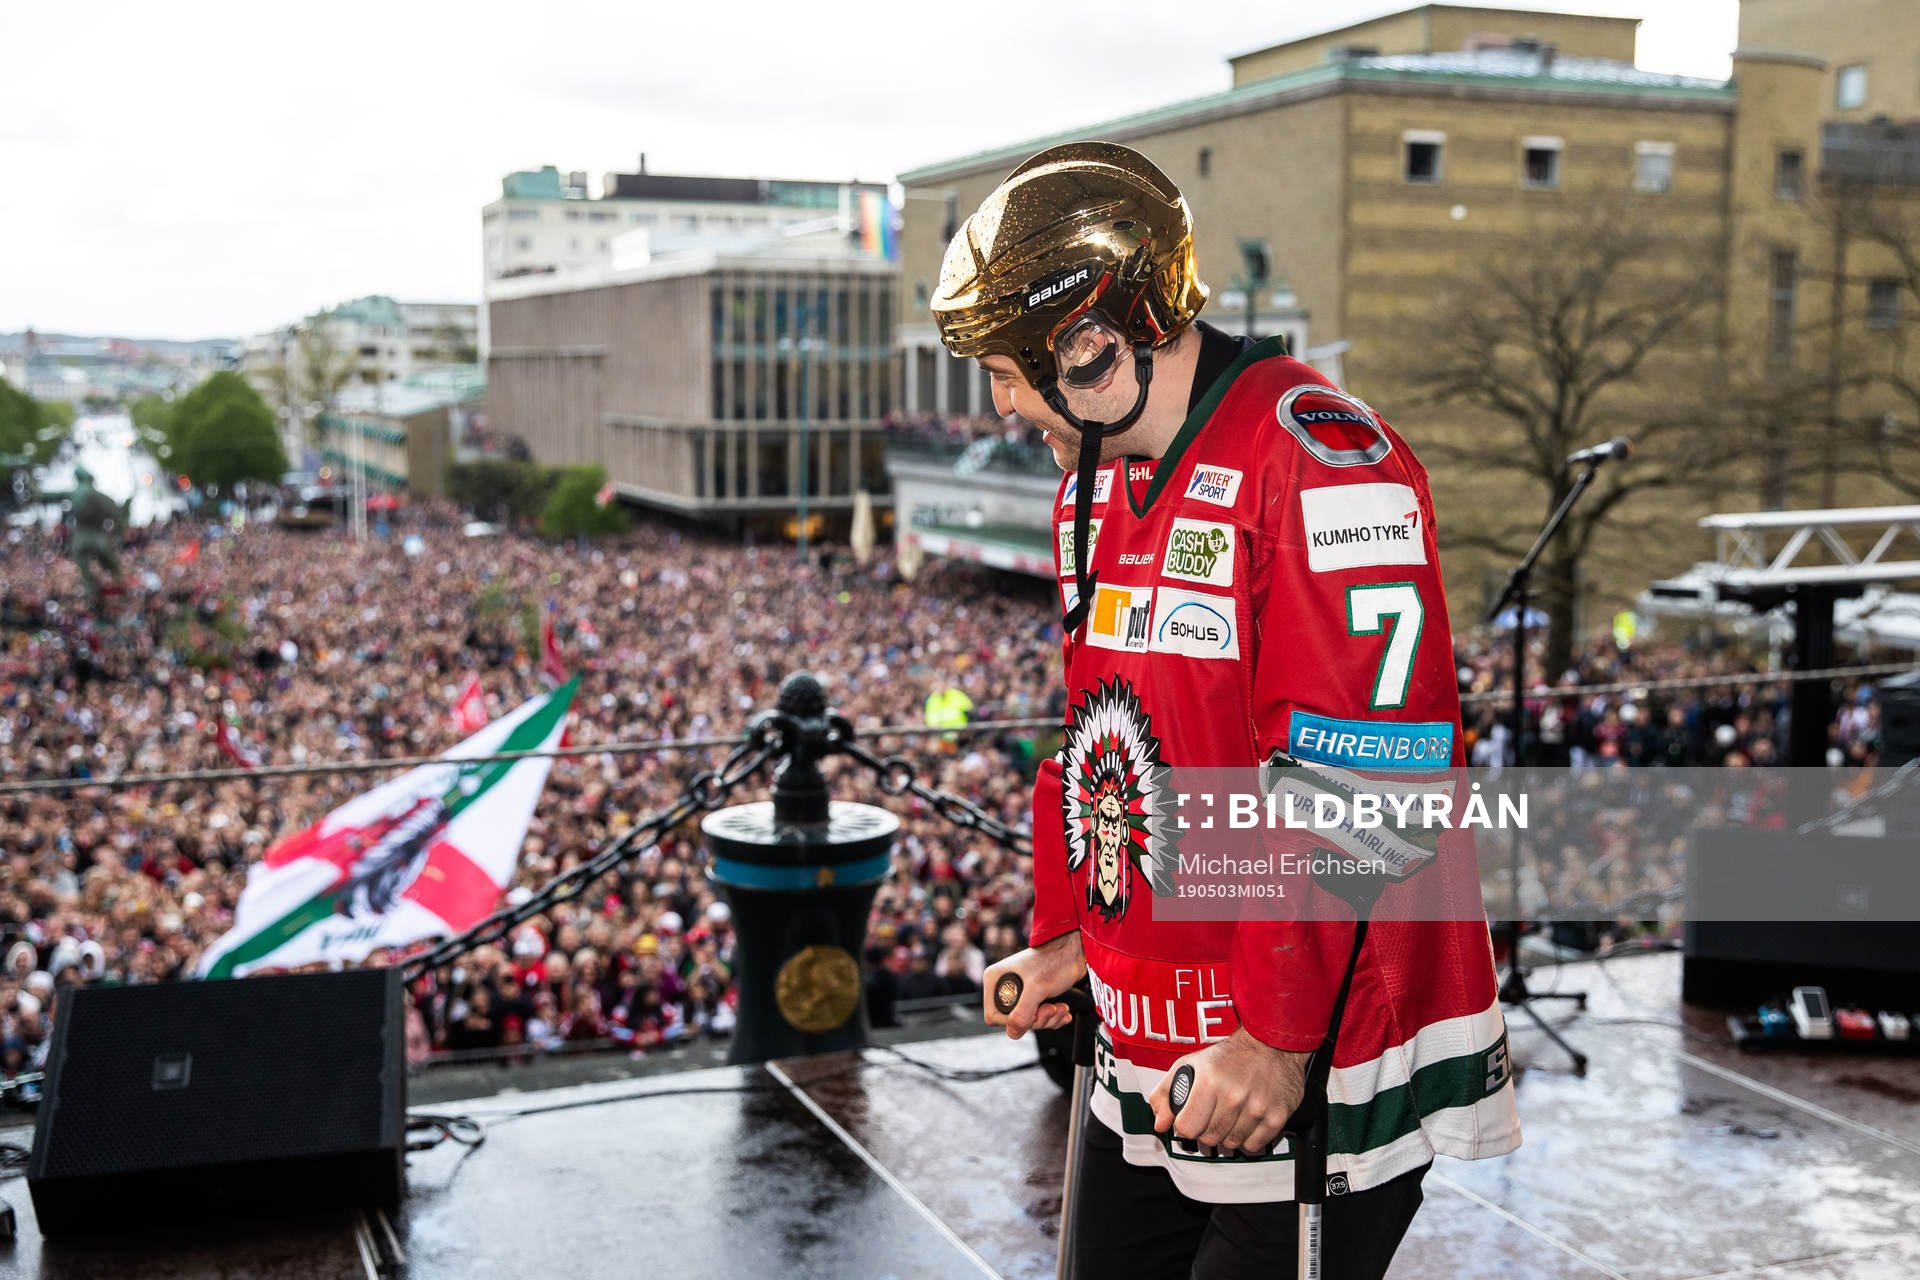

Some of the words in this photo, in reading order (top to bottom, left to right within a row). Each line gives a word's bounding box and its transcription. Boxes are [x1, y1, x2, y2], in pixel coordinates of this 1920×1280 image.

[1298, 410, 1372, 426] VOLVO
[1129, 466, 1154, 482] SHL
[1202, 471, 1231, 488] INTER
[1197, 483, 1227, 501] SPORT
[1171, 529, 1205, 555] CASH
[1312, 526, 1371, 548] KUMHO
[1372, 524, 1410, 541] TYRE
[1167, 551, 1215, 578] BUDDY
[1170, 621, 1219, 642] BOHUS
[1345, 581, 1425, 711] 7
[1296, 726, 1450, 761] EHRENBORG
[1353, 827, 1410, 868] AIRLINES
